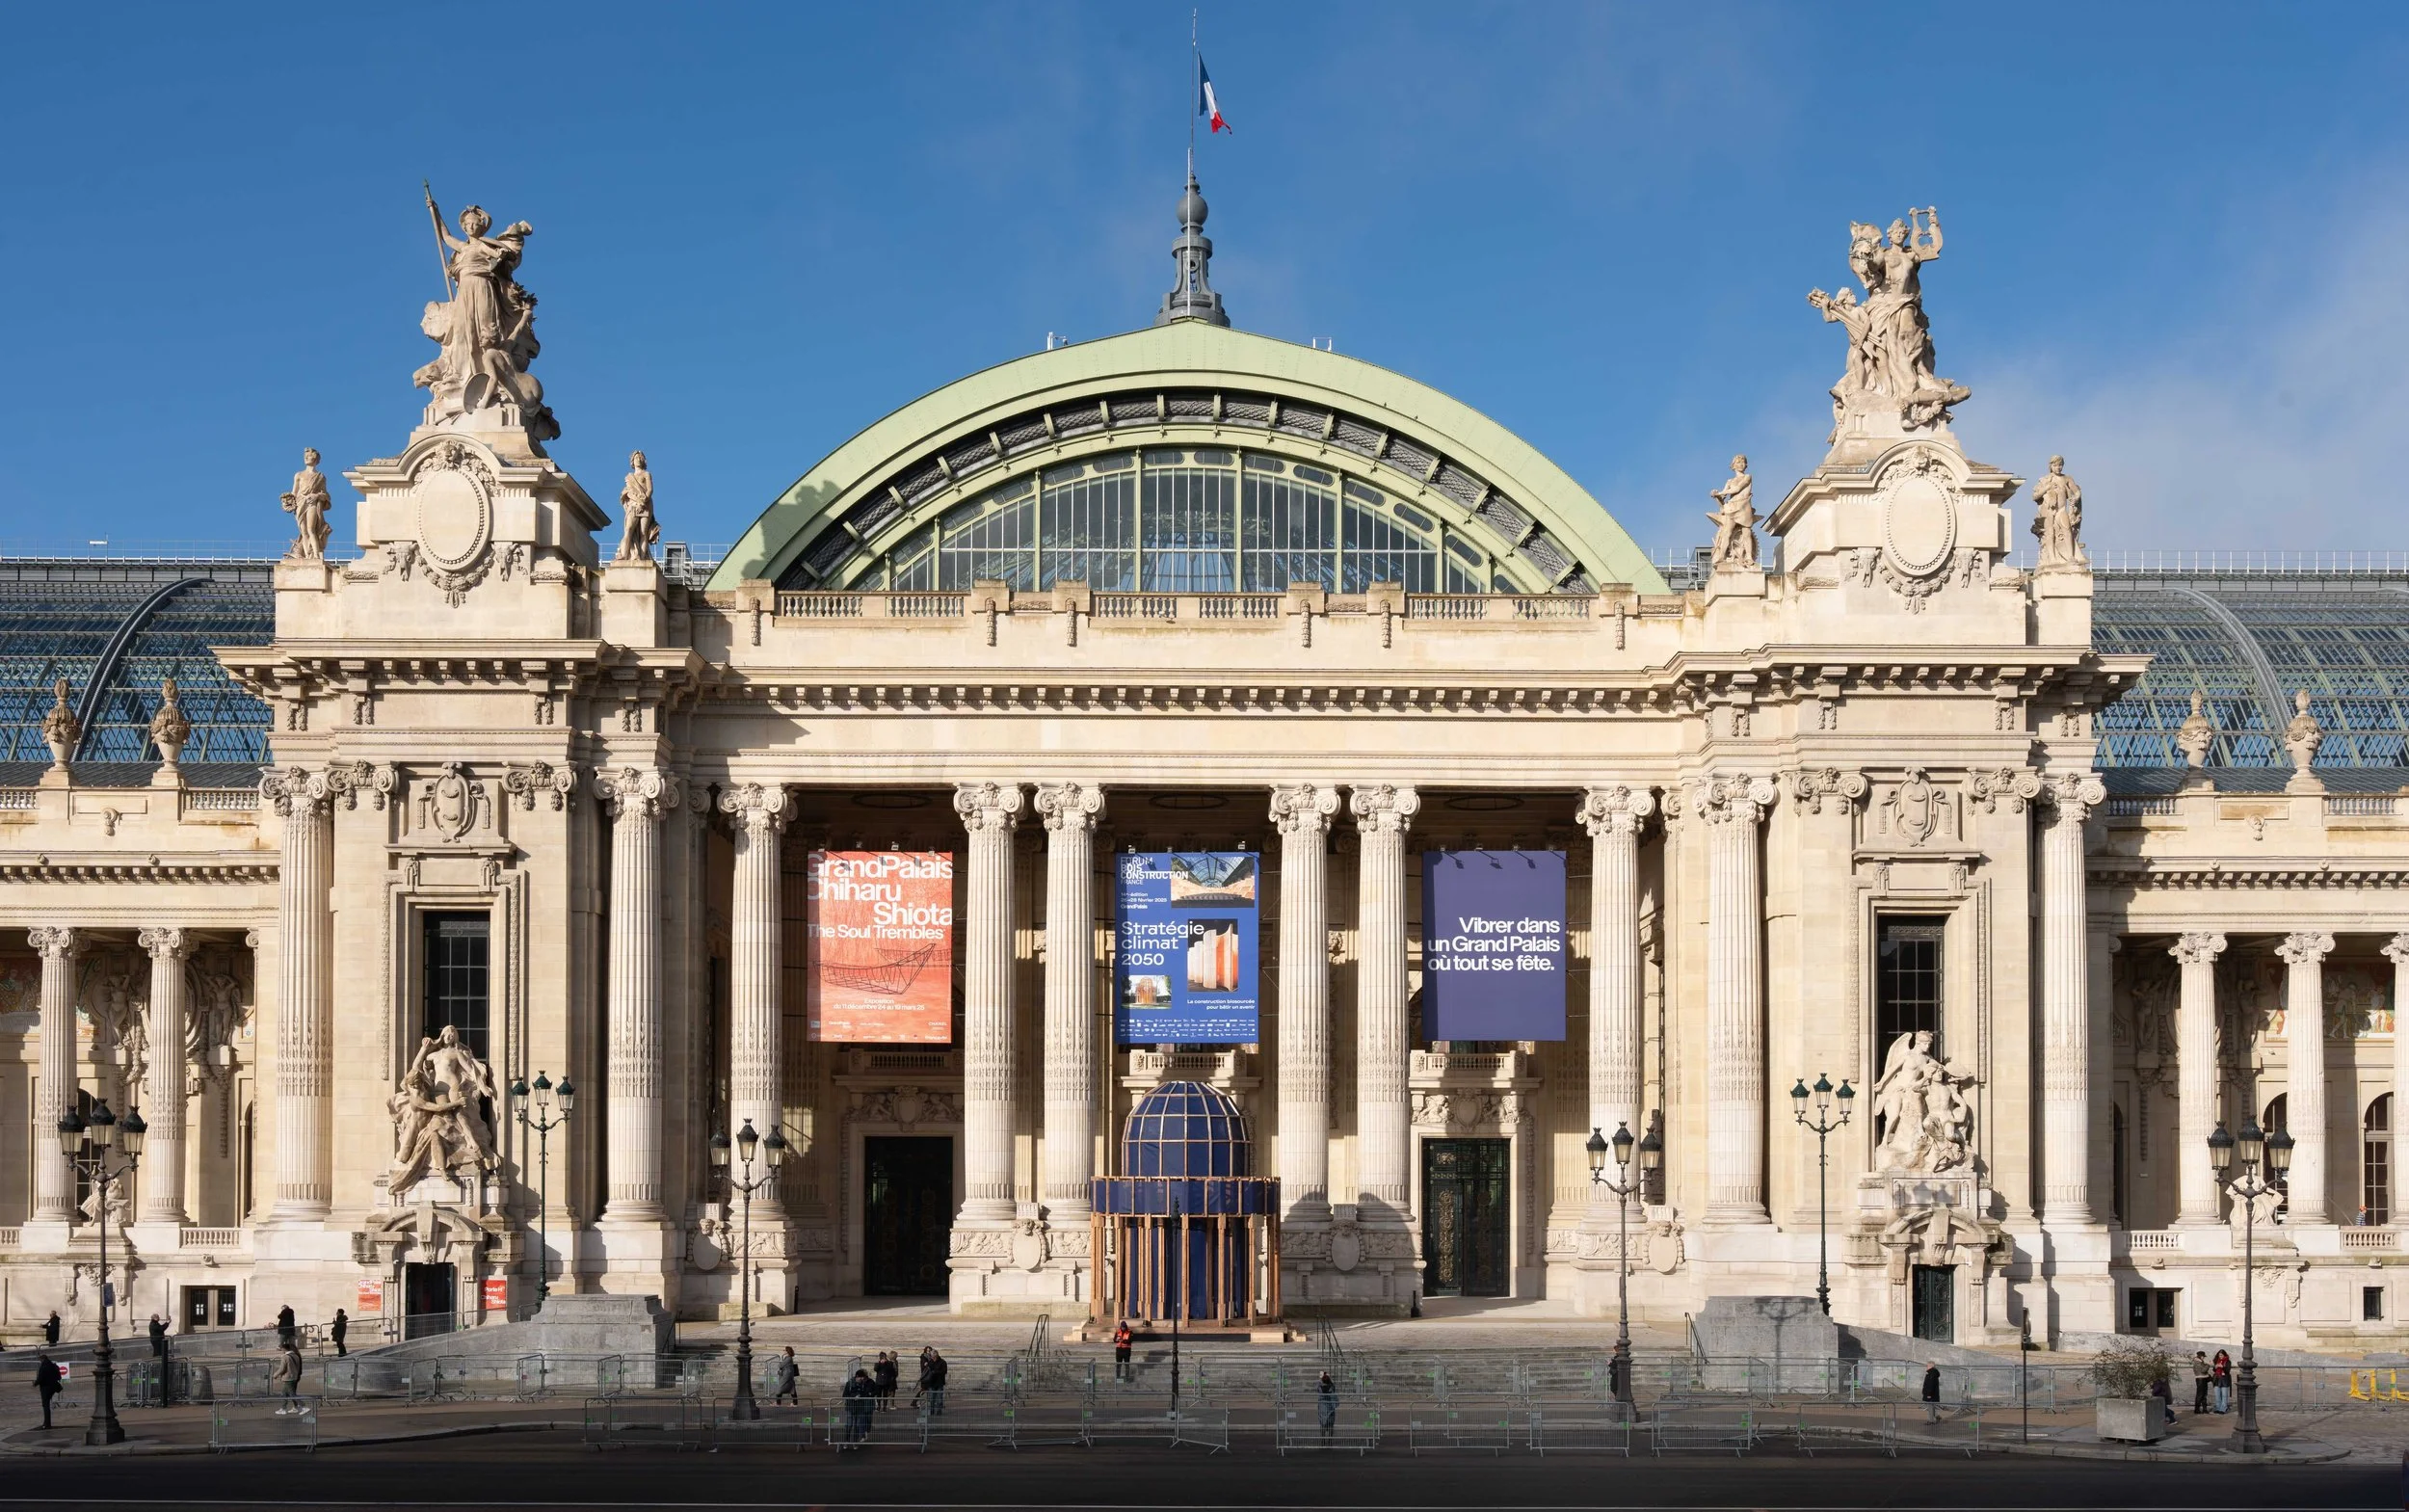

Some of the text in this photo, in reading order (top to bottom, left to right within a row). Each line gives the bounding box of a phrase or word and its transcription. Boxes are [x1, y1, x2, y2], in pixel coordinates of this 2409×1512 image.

[807, 854, 952, 879] GrandPalais
[1121, 863, 1143, 872] BOIS
[1121, 870, 1189, 880] CONSTRUCTION
[807, 876, 902, 901] Chiharu
[873, 901, 952, 926] Shiota
[807, 923, 944, 940] The Soul Trembles
[1122, 920, 1204, 939] Stratégie
[1459, 916, 1560, 934] Vibrer dans
[1122, 936, 1178, 950] climat
[1427, 935, 1560, 952] un Grand Palais
[1122, 953, 1164, 966] 2050
[1427, 954, 1554, 971] où tout se fête.
